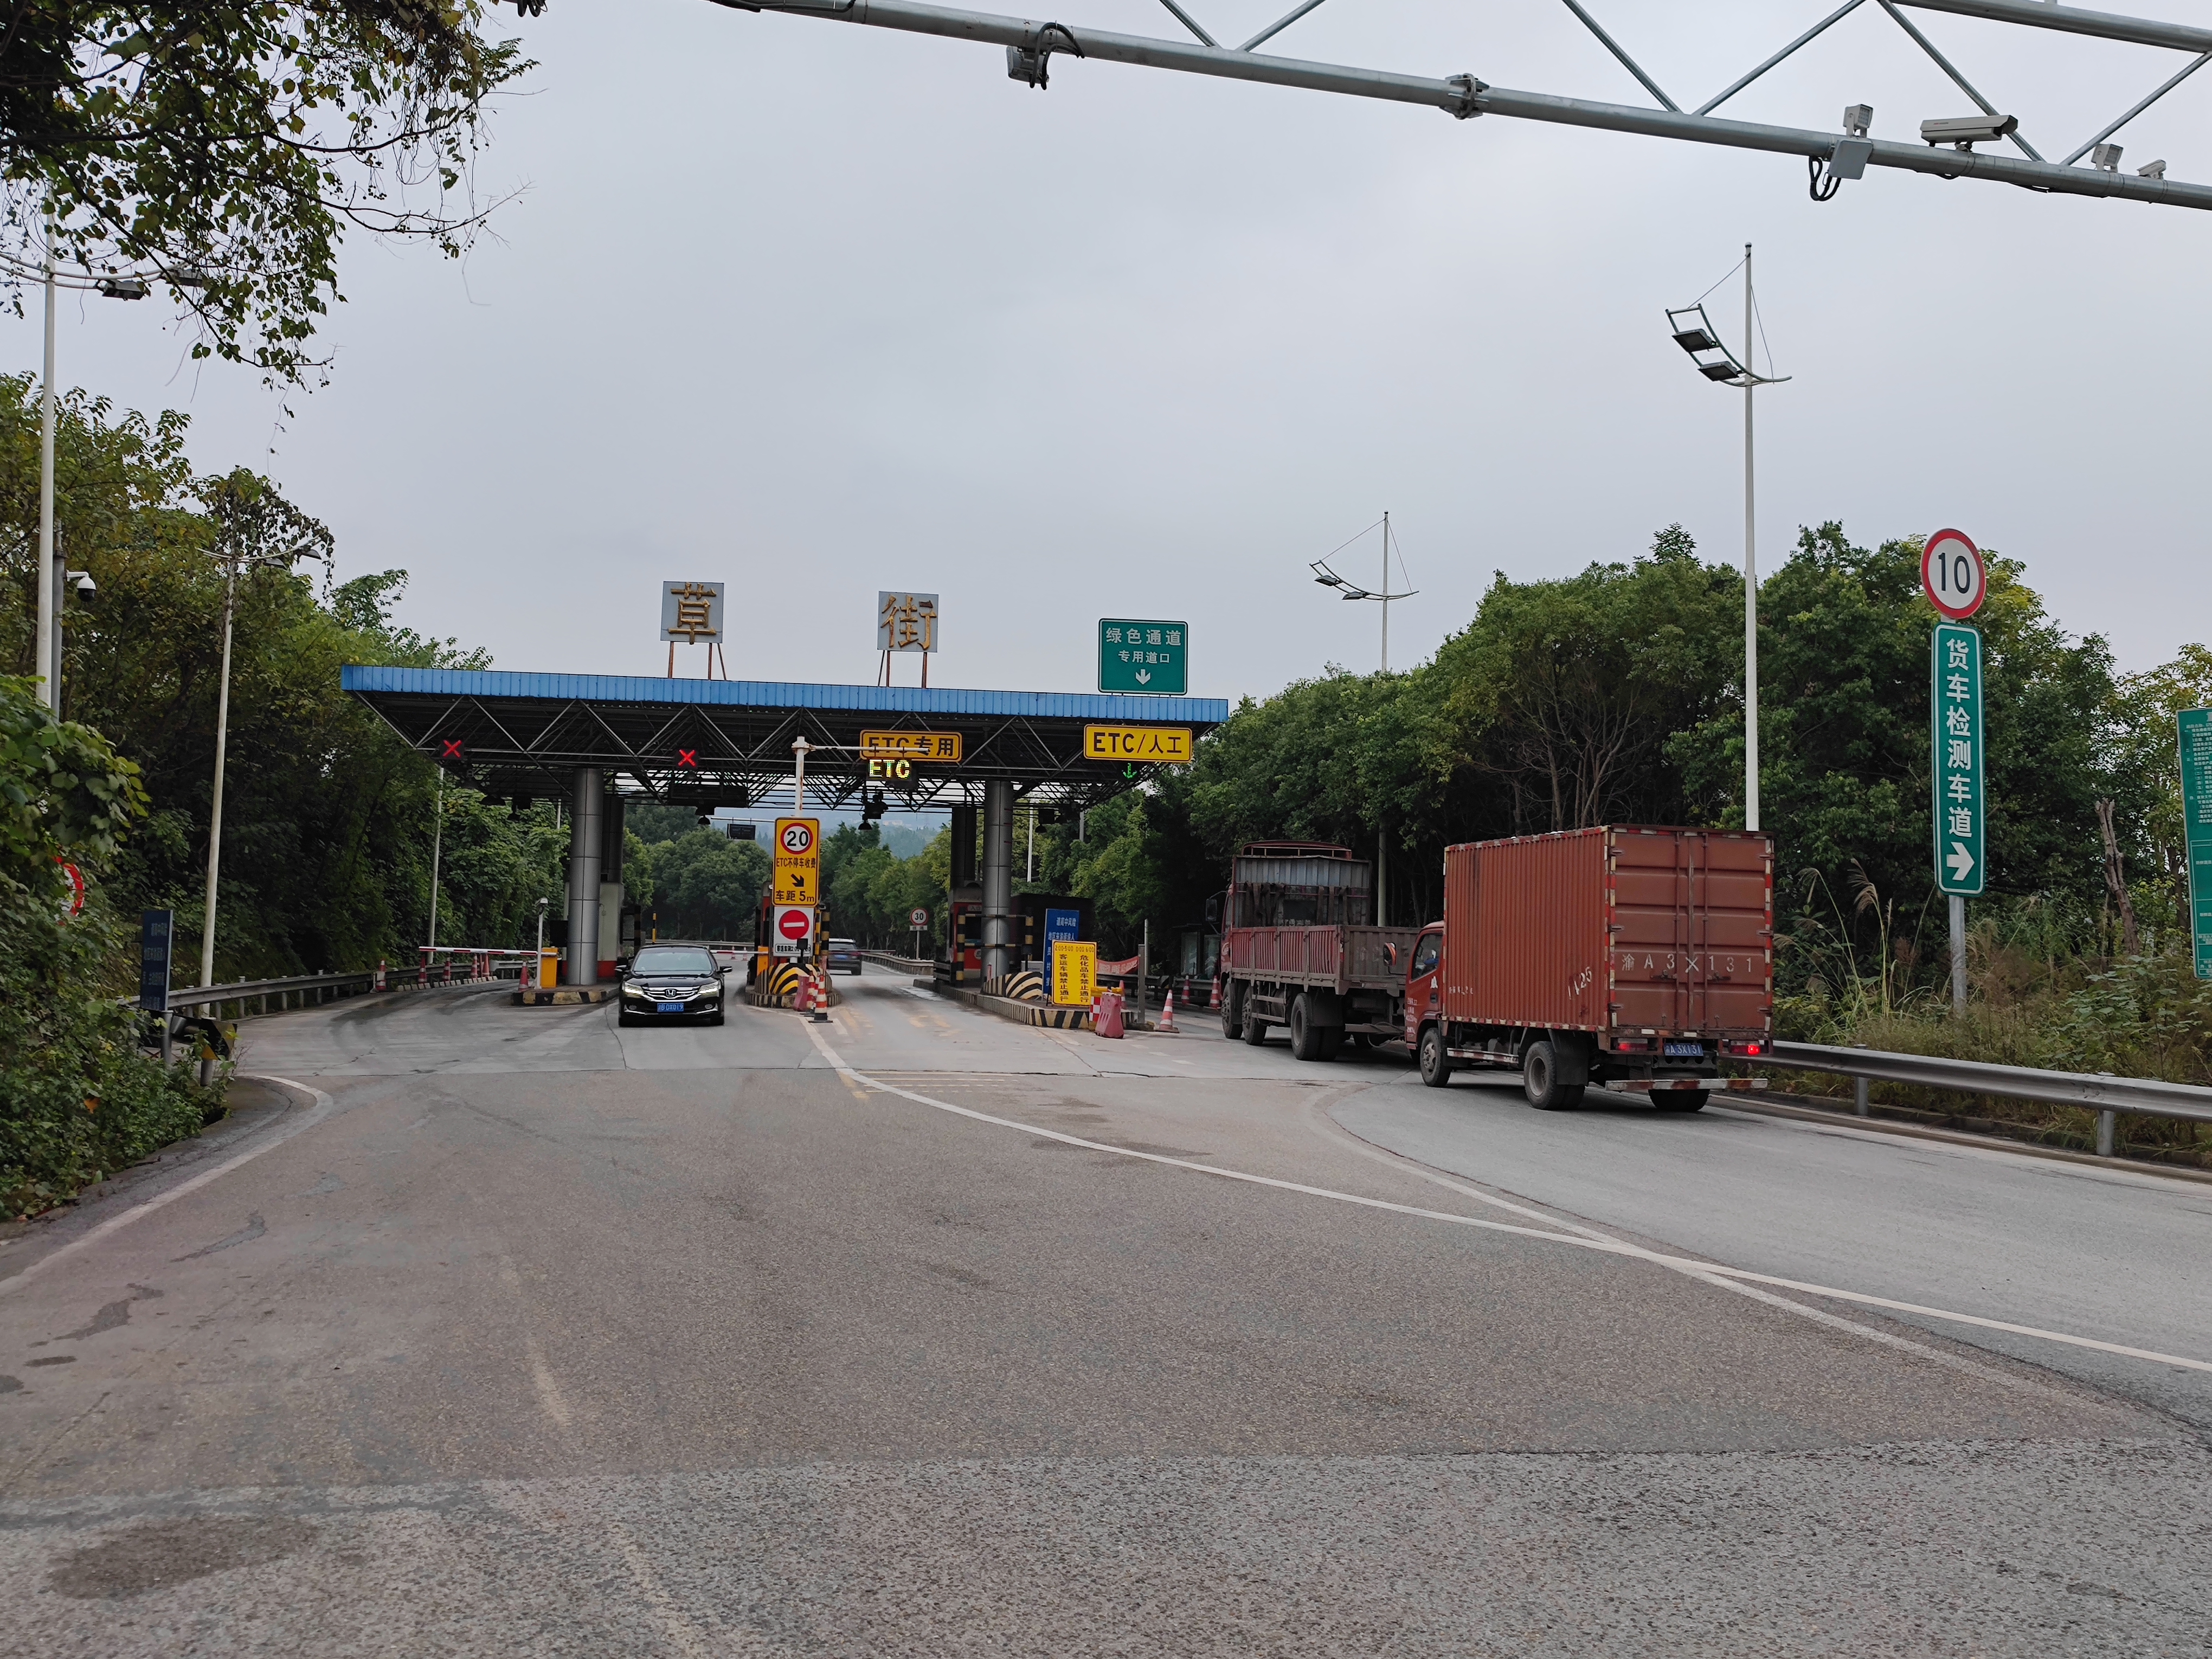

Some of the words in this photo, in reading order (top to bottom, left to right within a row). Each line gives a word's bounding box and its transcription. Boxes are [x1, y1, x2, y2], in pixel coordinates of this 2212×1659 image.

[1938, 552, 1970, 594] 10
[668, 582, 717, 645] 草
[880, 594, 936, 651] 街
[1106, 627, 1181, 646] 绿色通道
[1118, 650, 1169, 664] 专用道口
[869, 736, 954, 756] ETC专用
[1094, 732, 1182, 754] ETC/人工
[1946, 638, 1973, 838] 货车检测车道
[869, 759, 910, 780] ETC
[787, 831, 808, 846] 20
[776, 857, 816, 869] ETC不停车收费
[776, 890, 795, 901] 车距
